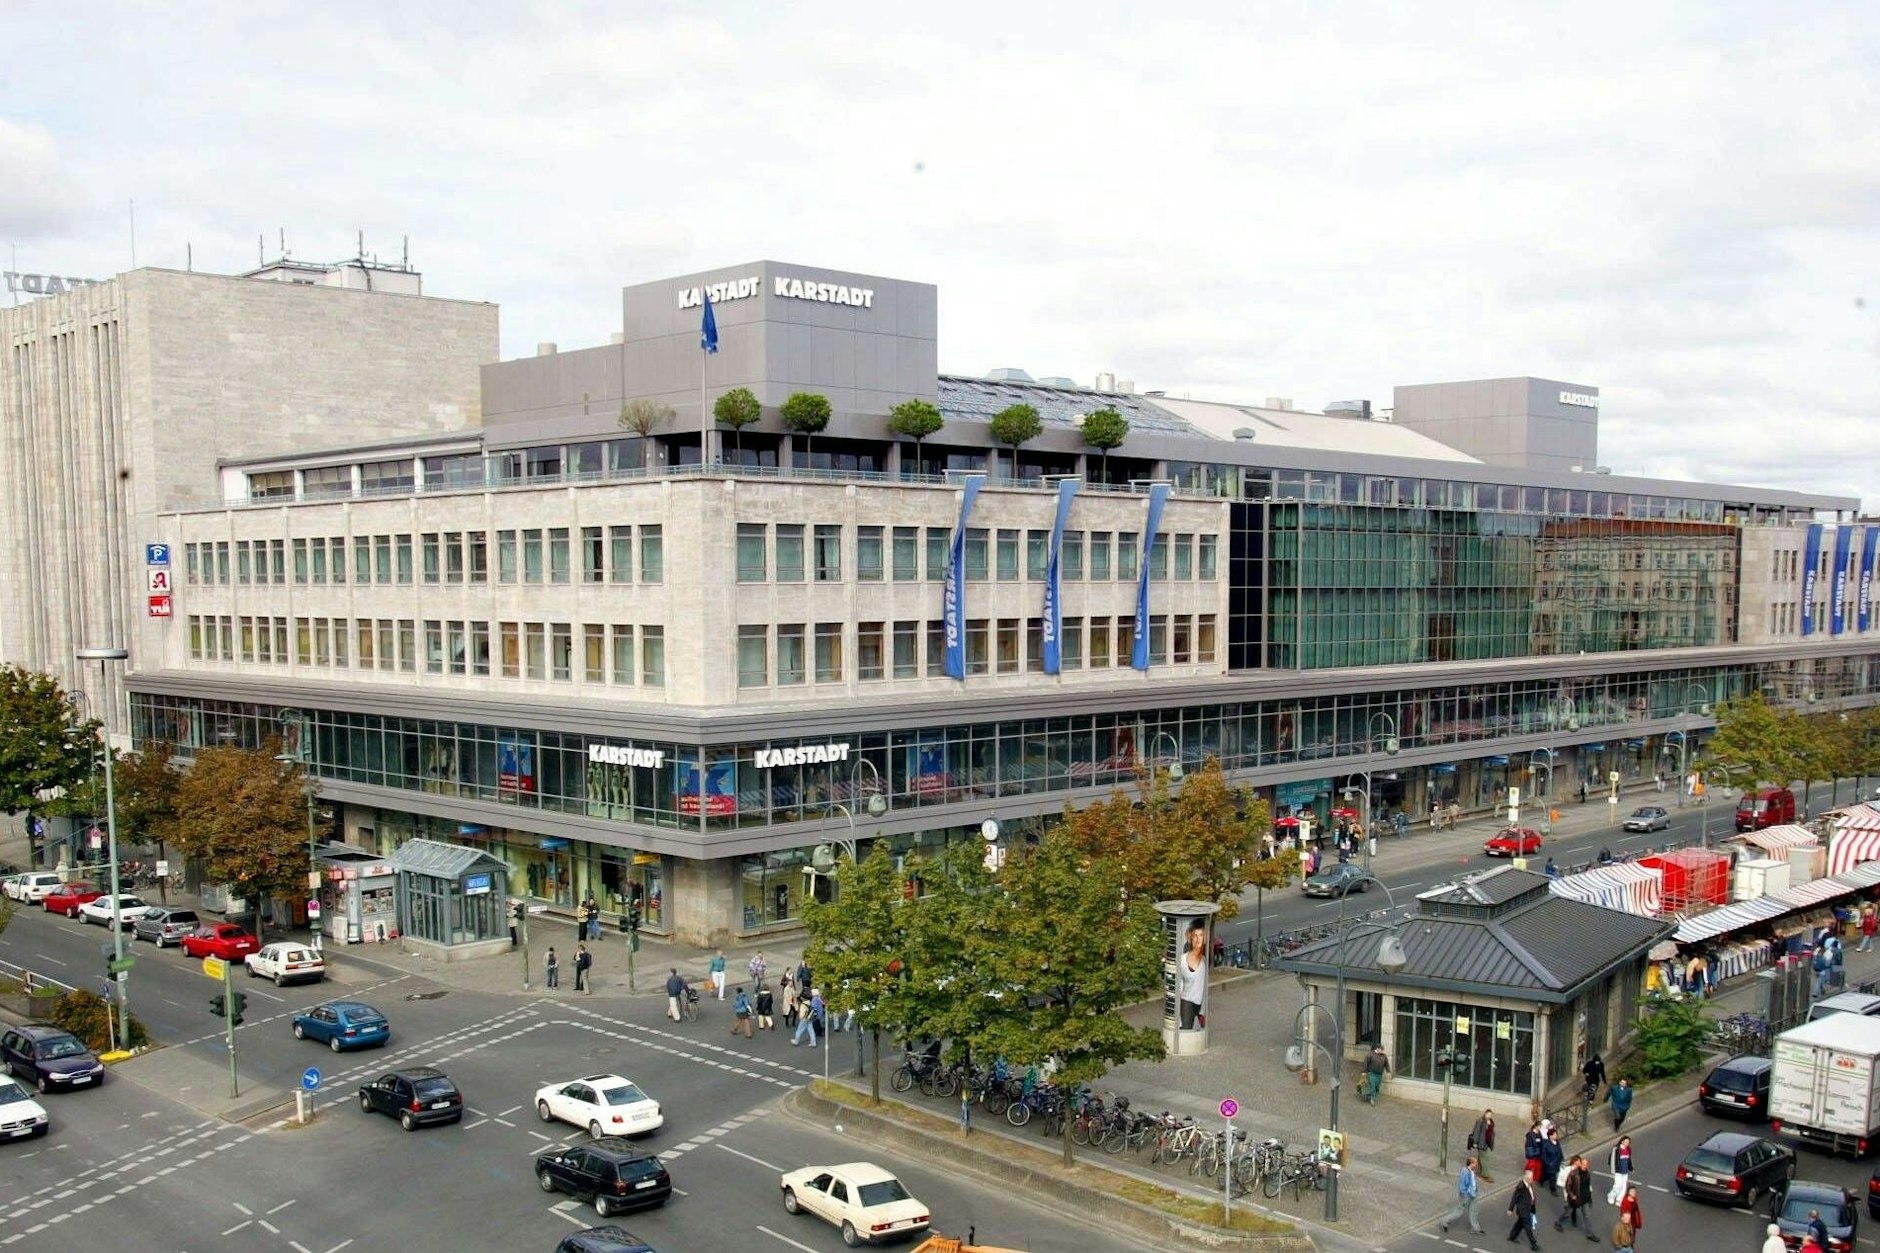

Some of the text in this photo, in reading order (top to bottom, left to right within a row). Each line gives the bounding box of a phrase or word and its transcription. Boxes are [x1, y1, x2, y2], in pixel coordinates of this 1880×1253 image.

[774, 276, 874, 309] KARSTADT
[588, 743, 666, 769] KARSTADT
[754, 742, 850, 769] KARSTADT
